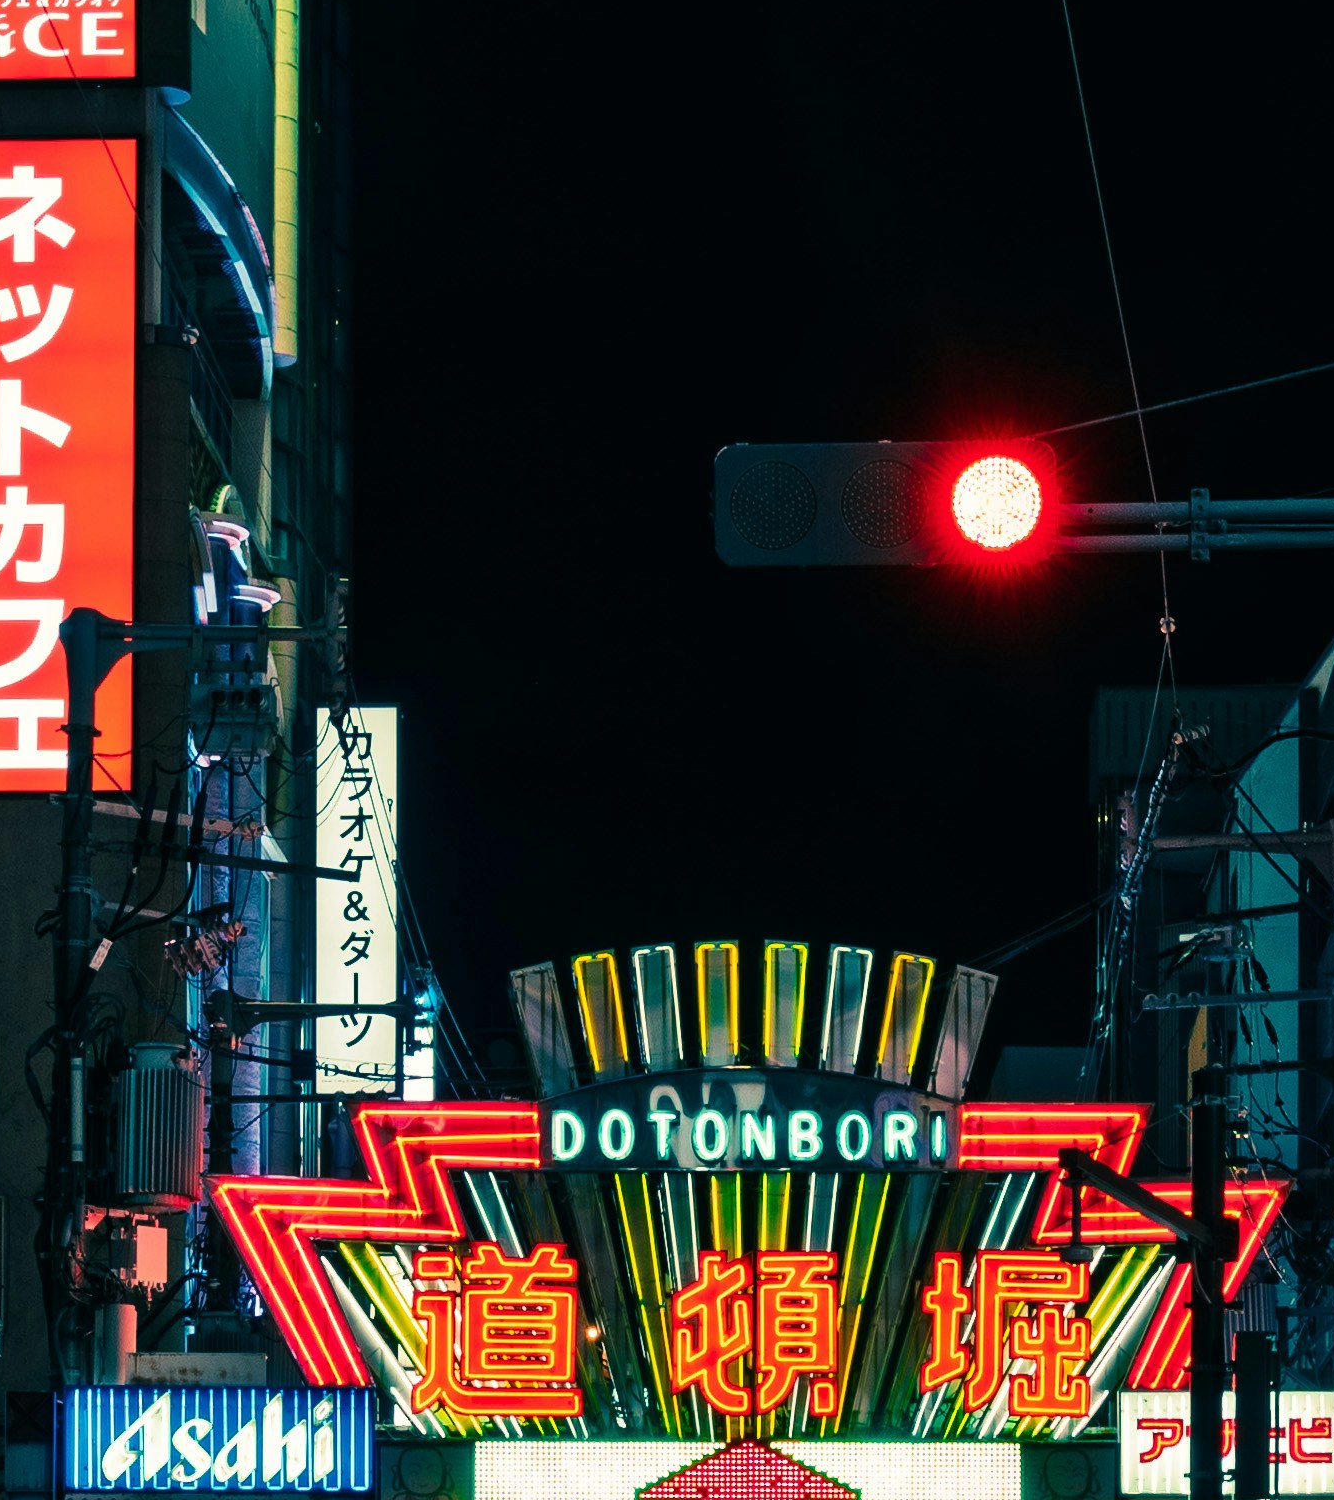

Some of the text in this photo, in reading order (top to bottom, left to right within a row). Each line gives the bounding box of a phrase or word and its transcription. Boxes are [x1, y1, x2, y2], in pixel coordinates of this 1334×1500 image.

[338, 723, 375, 1049] カラオケ&ダーツ
[548, 1108, 947, 1163] DOTONBORI
[412, 1242, 1093, 1420] 道頓堀
[101, 1390, 335, 1484] Asahi
